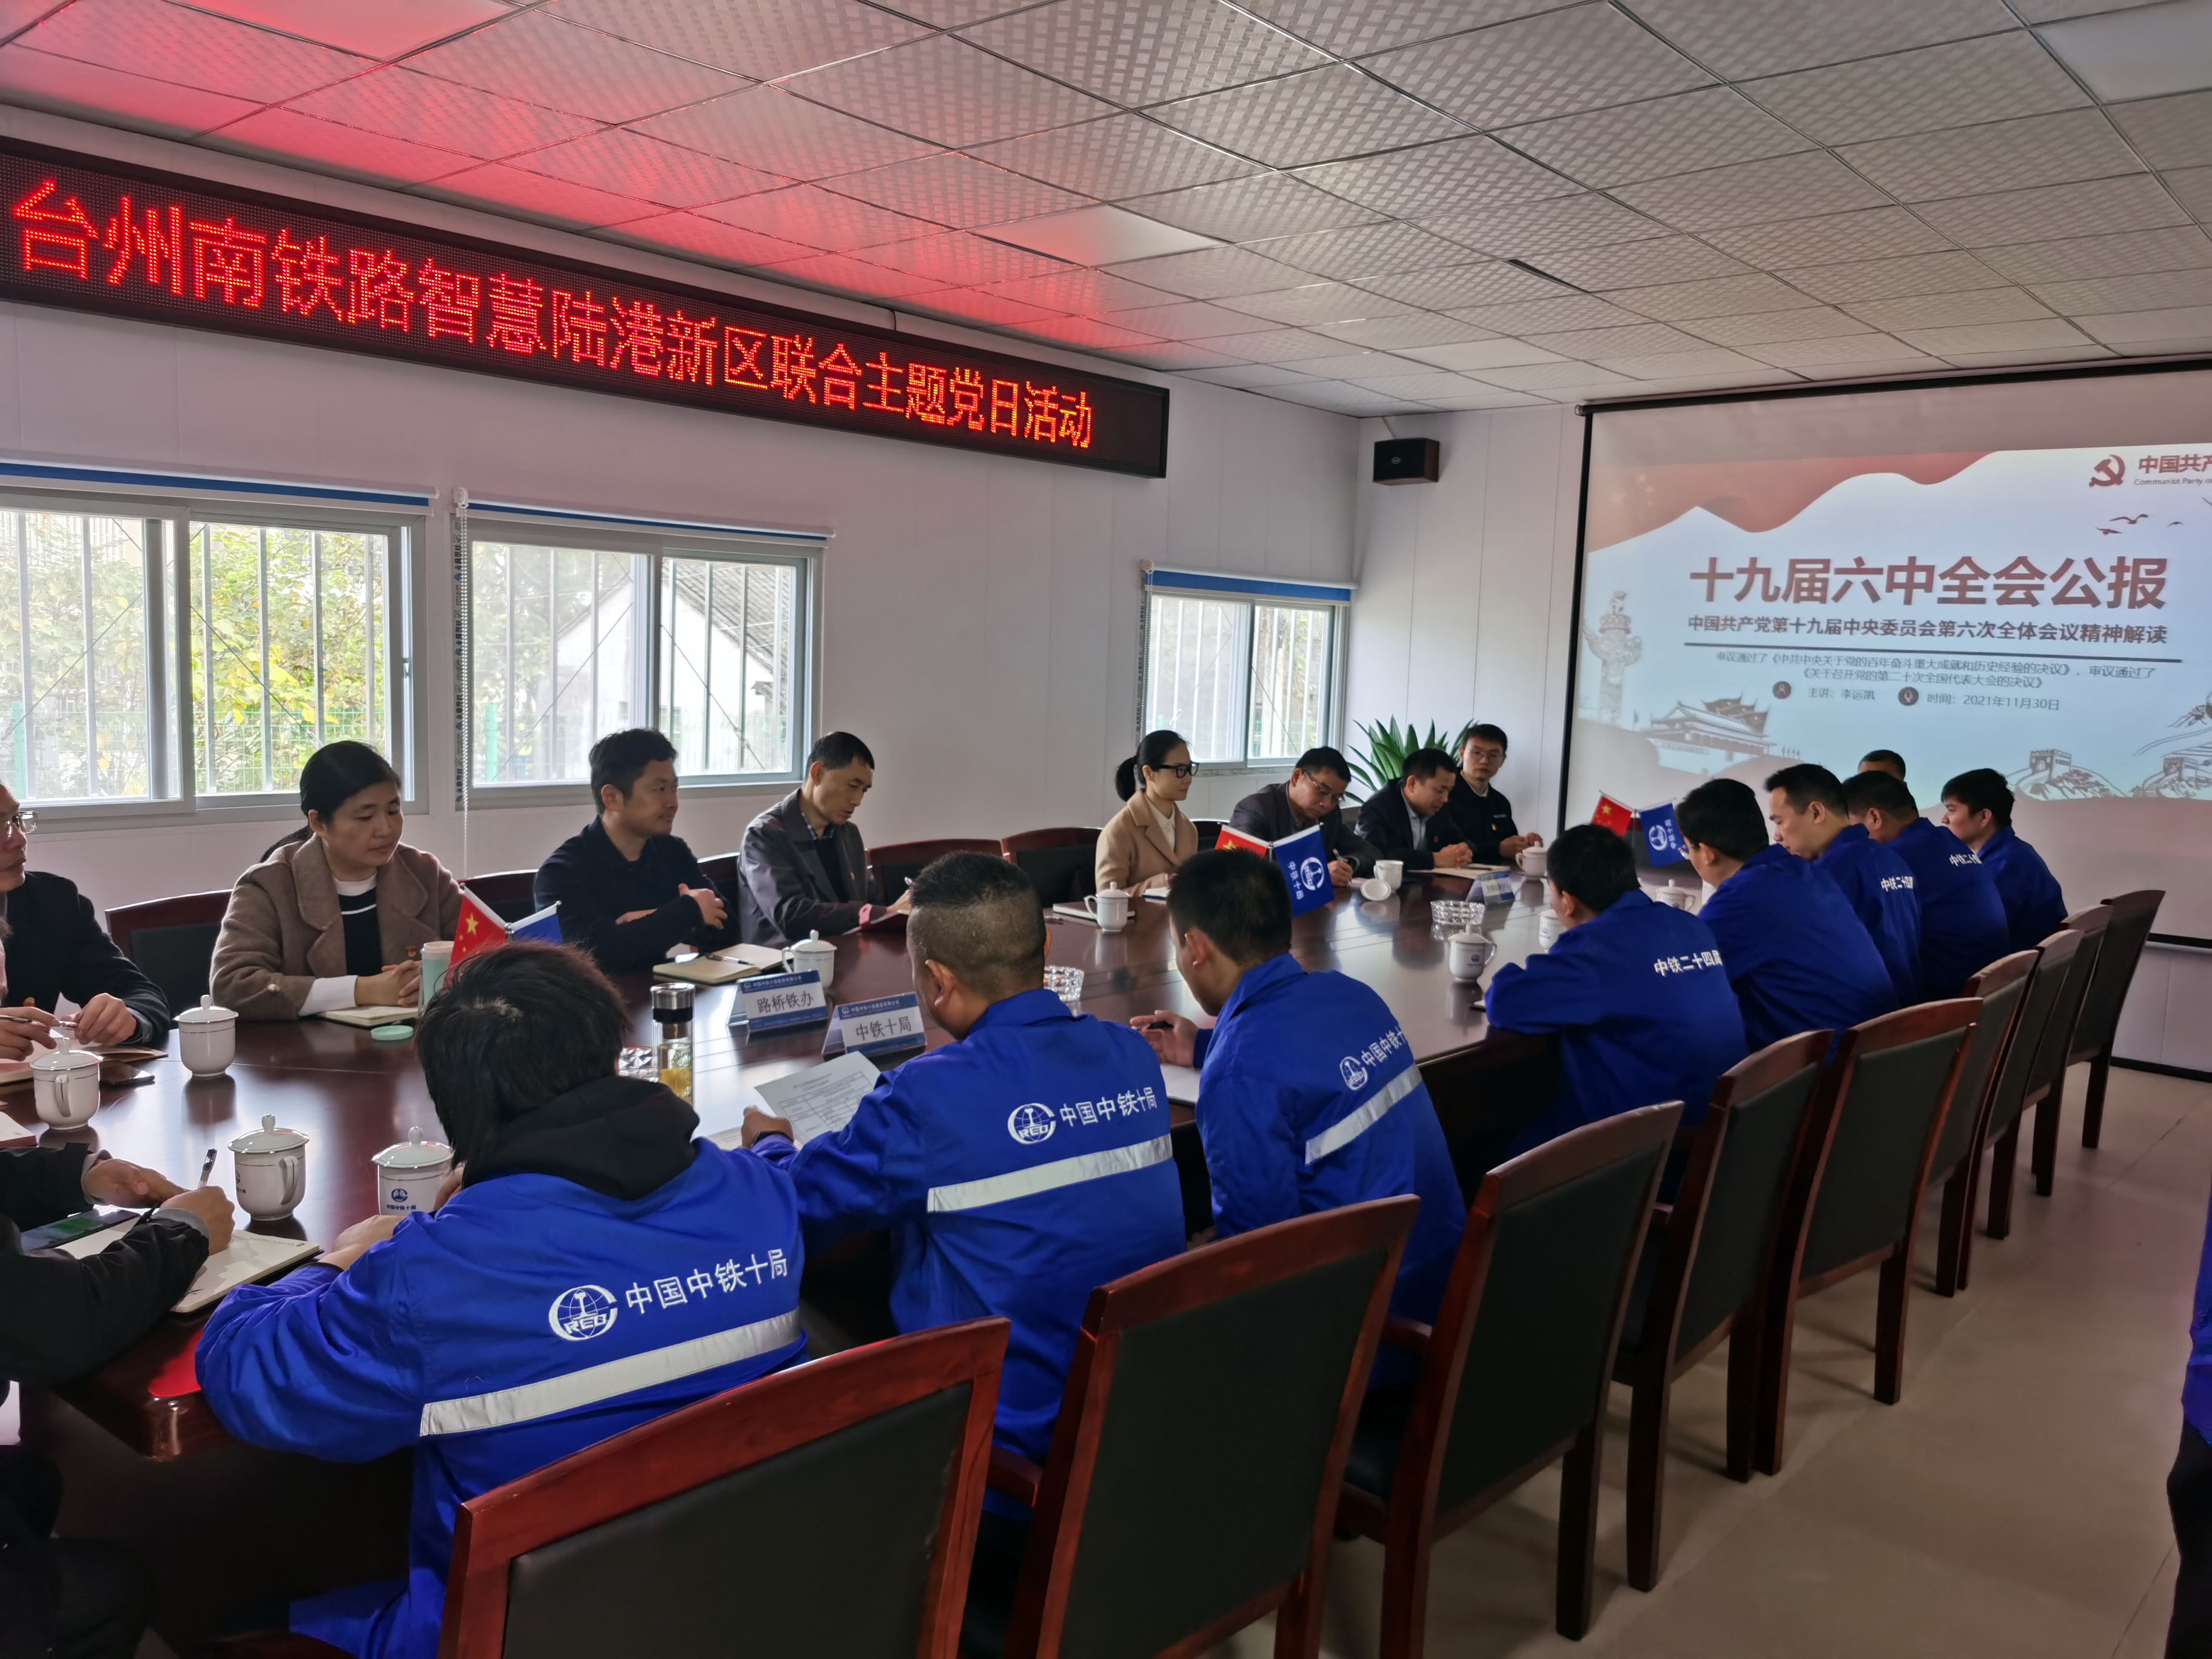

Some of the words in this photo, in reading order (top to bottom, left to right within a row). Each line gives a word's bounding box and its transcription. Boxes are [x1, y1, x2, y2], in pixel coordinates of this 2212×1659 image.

[12, 177, 1093, 447] 台州南铁路智慧陆港新区联合主题党日活动
[1690, 555, 2167, 609] 十九届六中全会公报
[1688, 615, 2168, 643] 中国共产党第十九届中央委员会第六次全体会议精神解读
[757, 990, 814, 1014] 路桥铁办
[856, 1016, 912, 1041] 中铁十局
[1060, 1087, 1157, 1127] 中国中铁十局
[625, 1248, 788, 1315] 中国中铁十局
